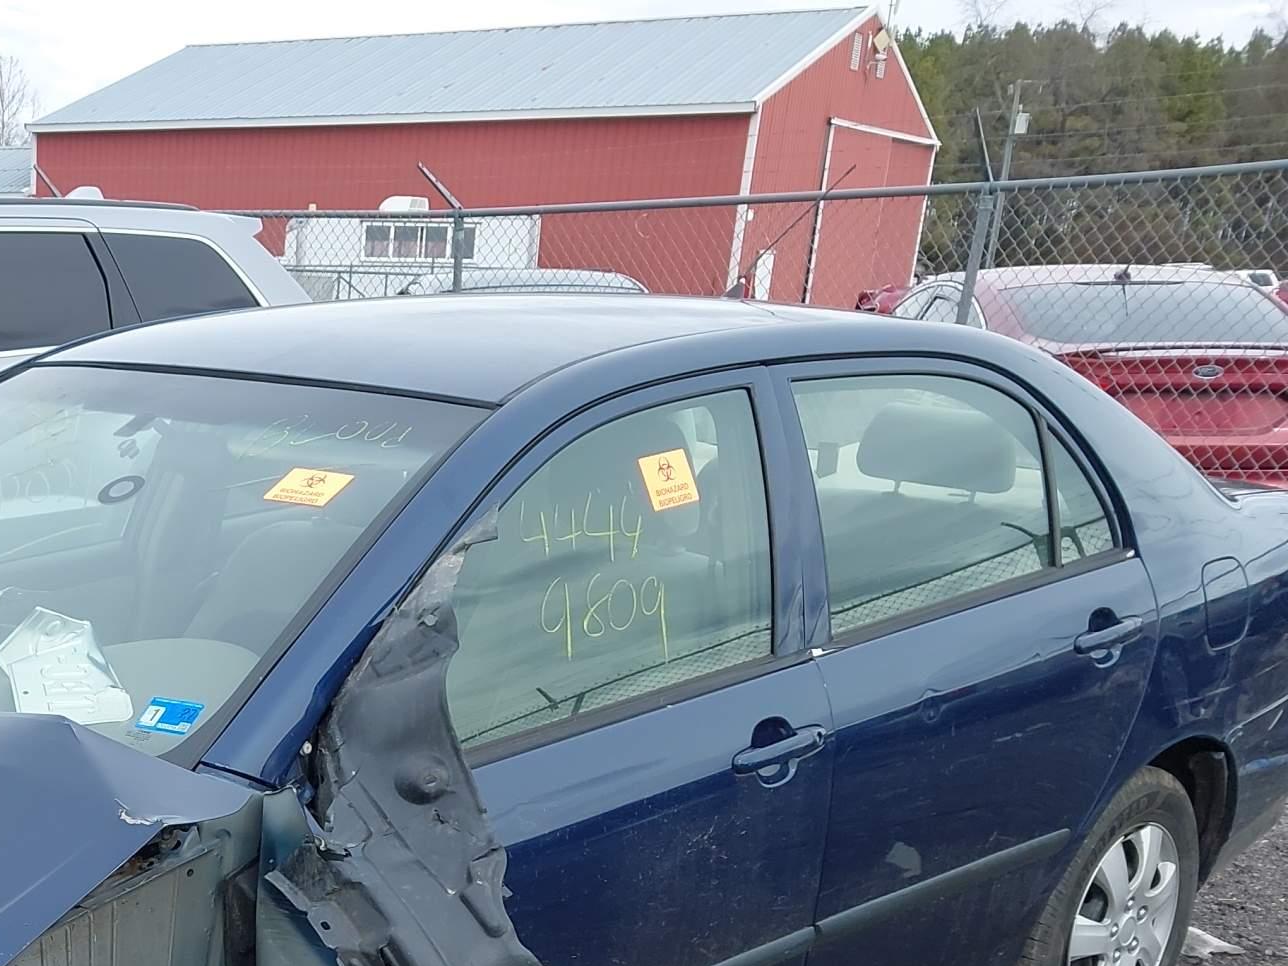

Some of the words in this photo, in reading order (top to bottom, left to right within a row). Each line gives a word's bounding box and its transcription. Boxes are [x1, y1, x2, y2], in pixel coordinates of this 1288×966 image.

[519, 482, 644, 561] 4444
[656, 482, 689, 496] BIOHAZARD
[540, 573, 669, 663] 9809
